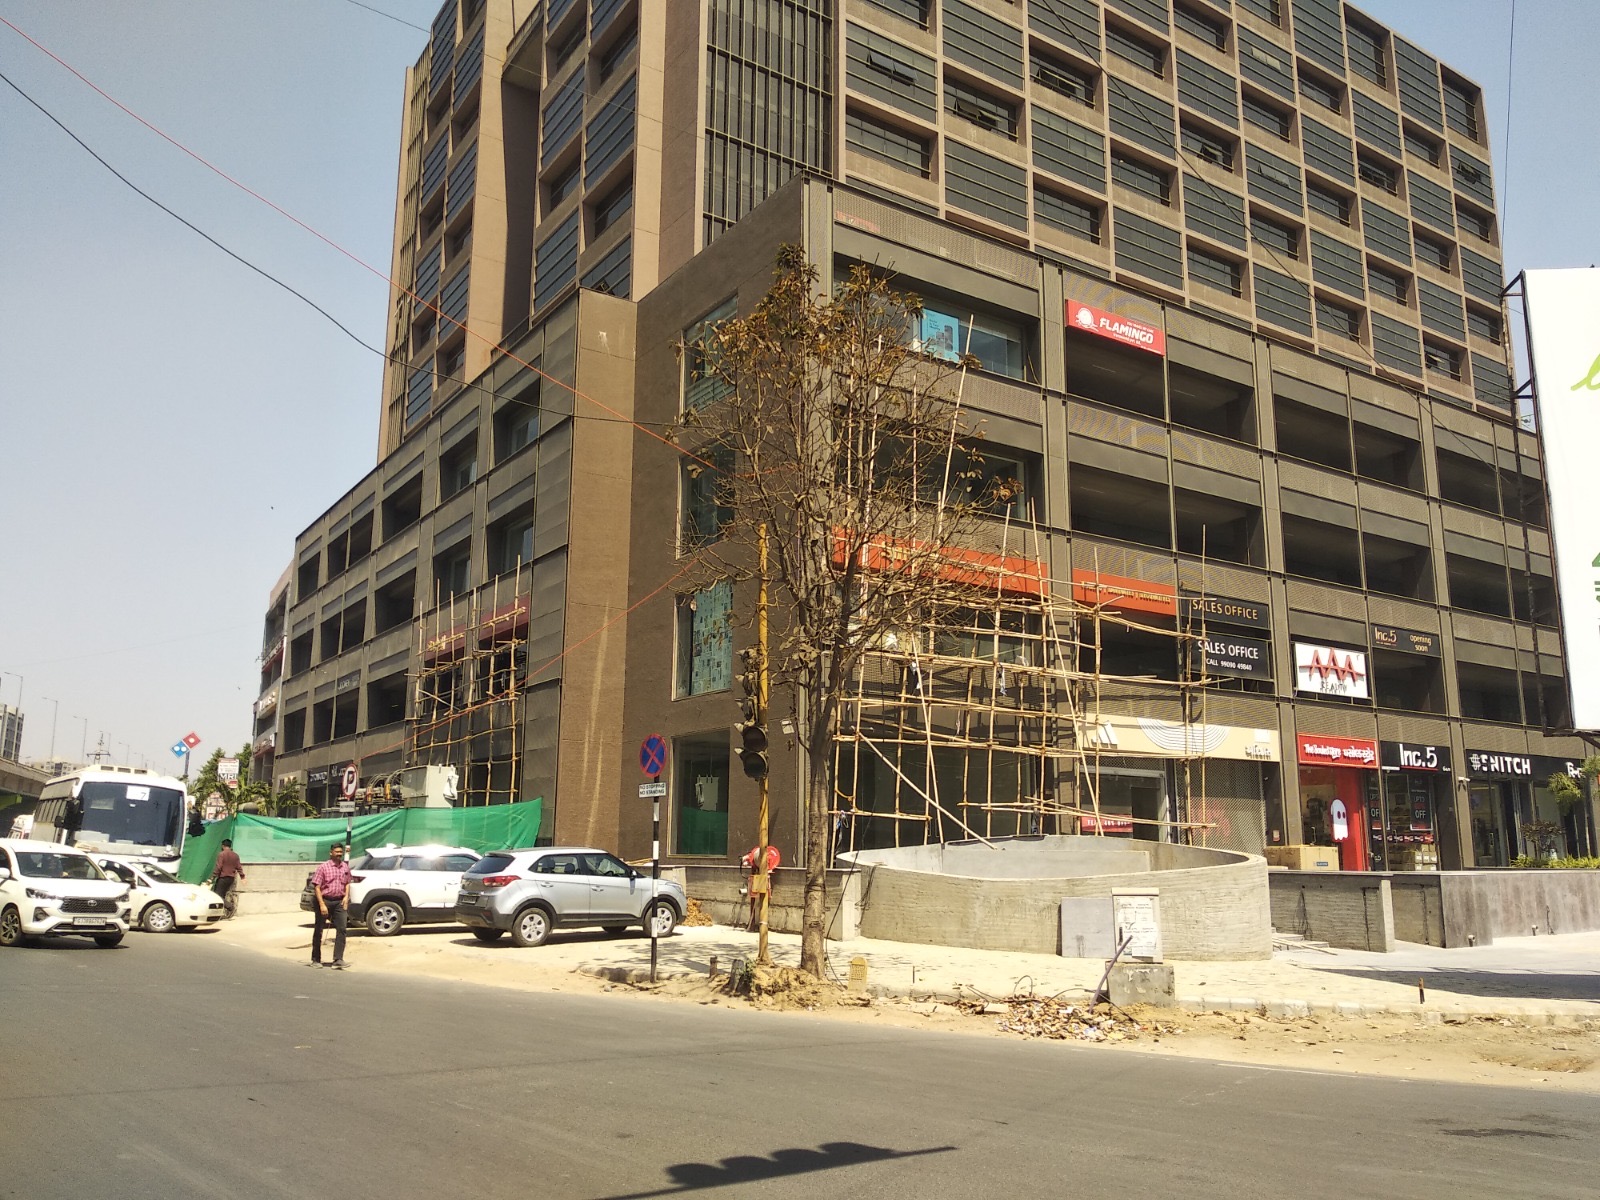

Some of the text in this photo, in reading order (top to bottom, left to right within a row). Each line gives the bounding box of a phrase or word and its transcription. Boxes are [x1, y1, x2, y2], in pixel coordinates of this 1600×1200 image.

[1099, 318, 1154, 344] FLAMINGO
[1192, 600, 1258, 620] SALES OFFICE
[1375, 626, 1397, 643] Inc.5
[1197, 640, 1259, 660] SALES OFFICE
[1415, 644, 1429, 652] soon
[1206, 658, 1219, 666] CALL
[1399, 743, 1438, 768] Inc.5
[1415, 810, 1426, 818] OFF
